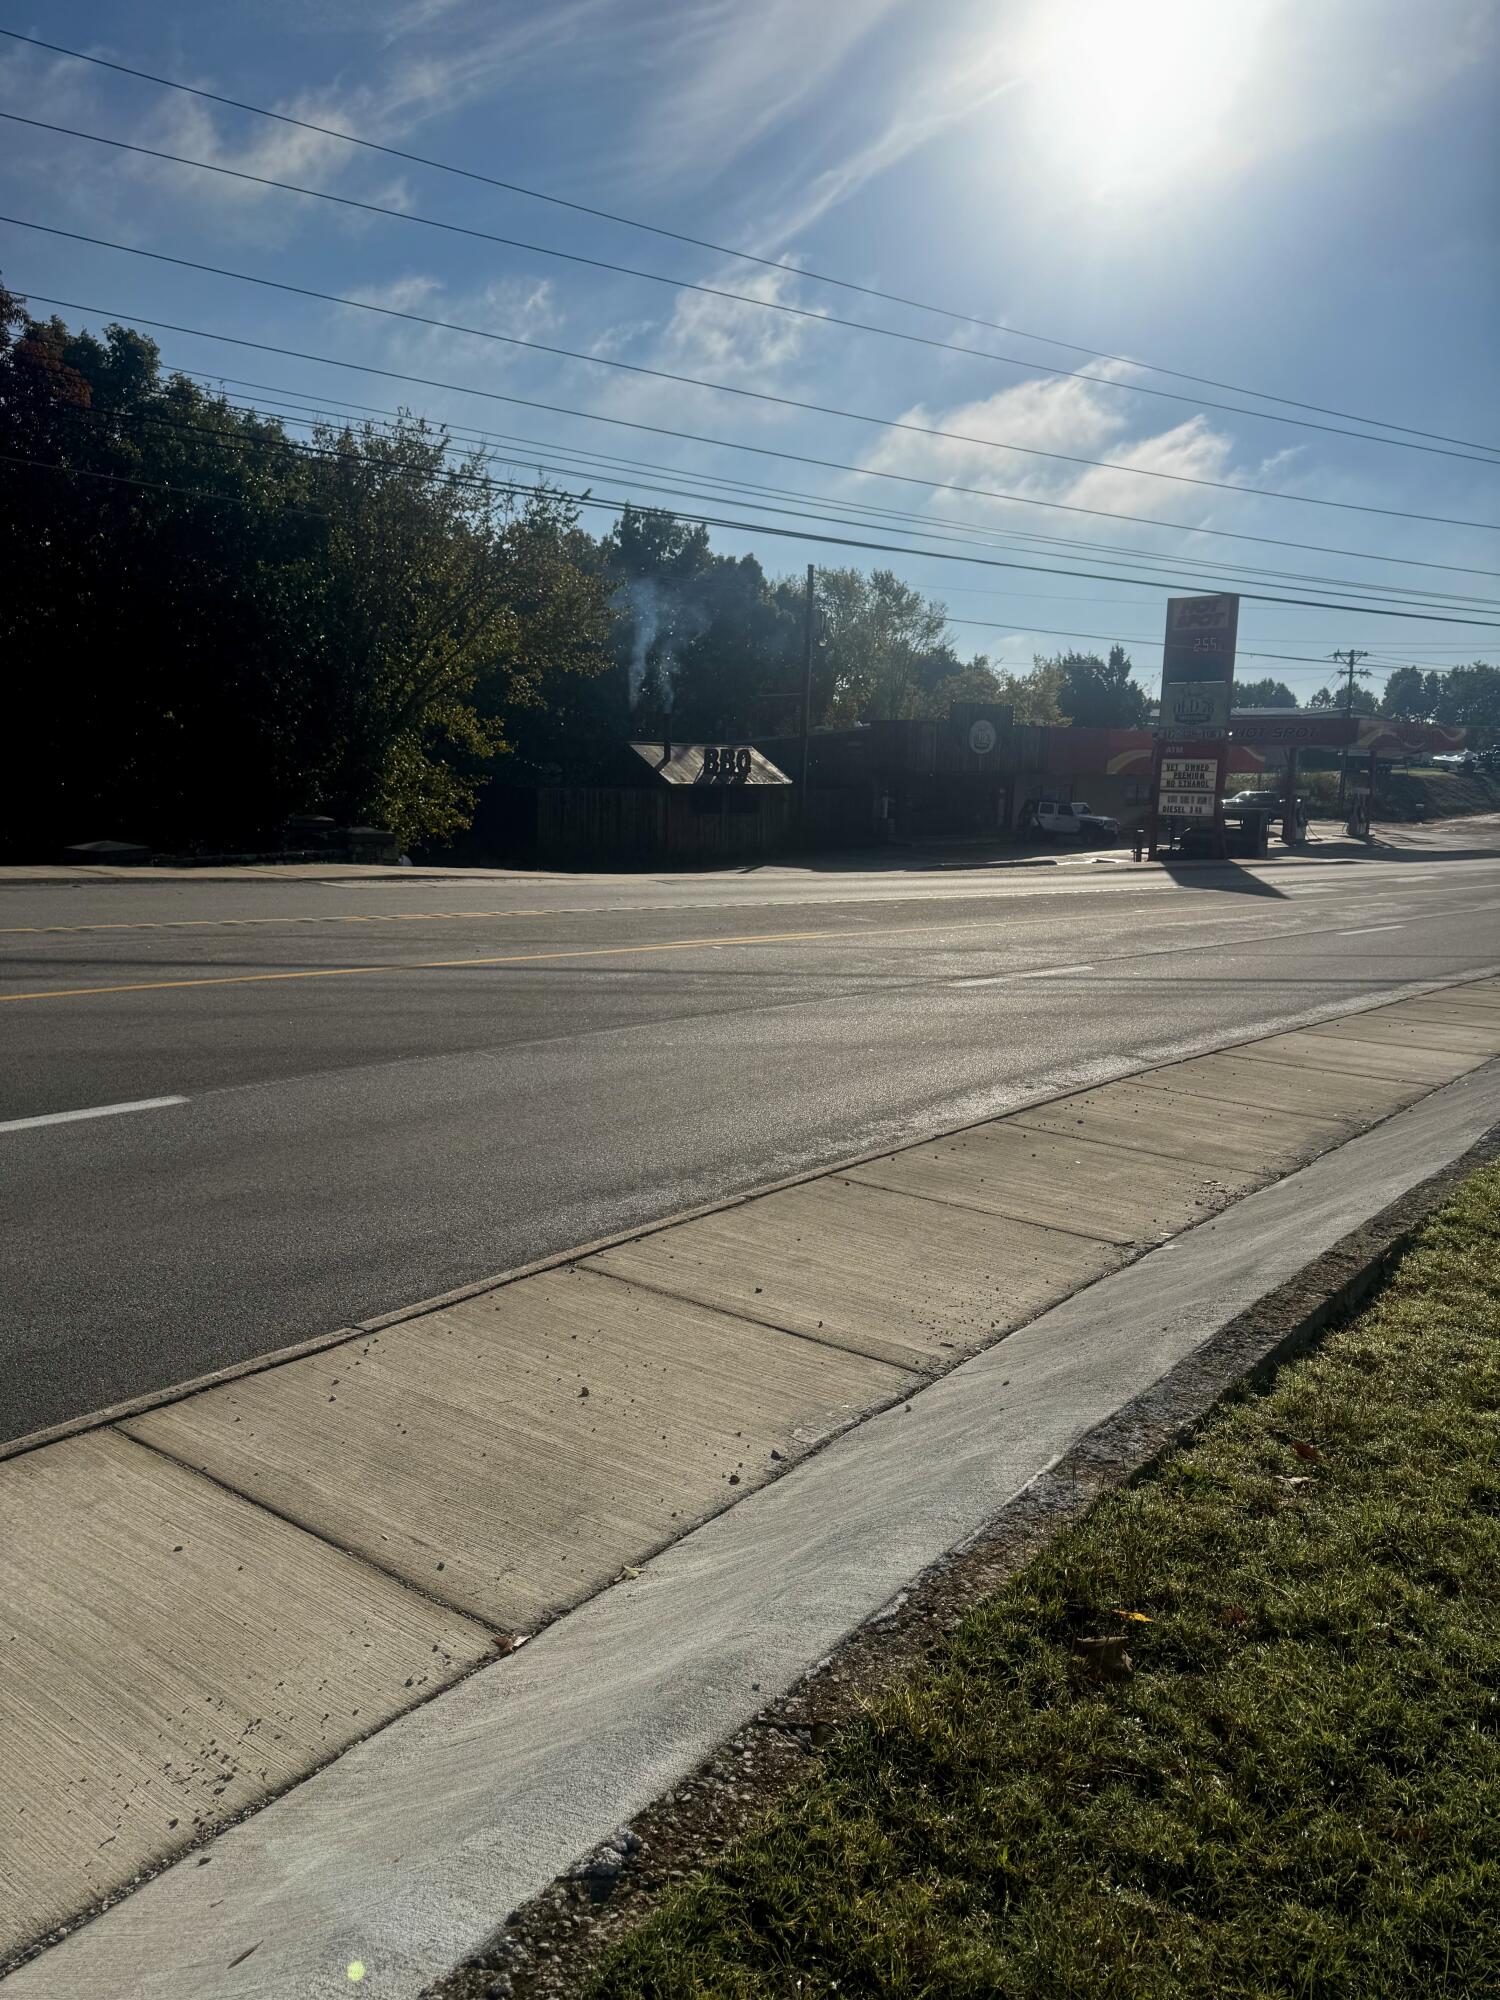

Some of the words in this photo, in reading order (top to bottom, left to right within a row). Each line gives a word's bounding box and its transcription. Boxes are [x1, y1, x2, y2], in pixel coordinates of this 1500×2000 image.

[1180, 599, 1222, 614] HOT
[1175, 613, 1226, 628] SPOT
[1233, 727, 1266, 738] HOT
[1272, 727, 1319, 738] SPOT
[704, 749, 751, 773] BBQ
[1166, 763, 1178, 771] VET
[1185, 763, 1209, 771] OWNED
[1166, 779, 1176, 788] NO
[1178, 780, 1210, 788] ETHANOL
